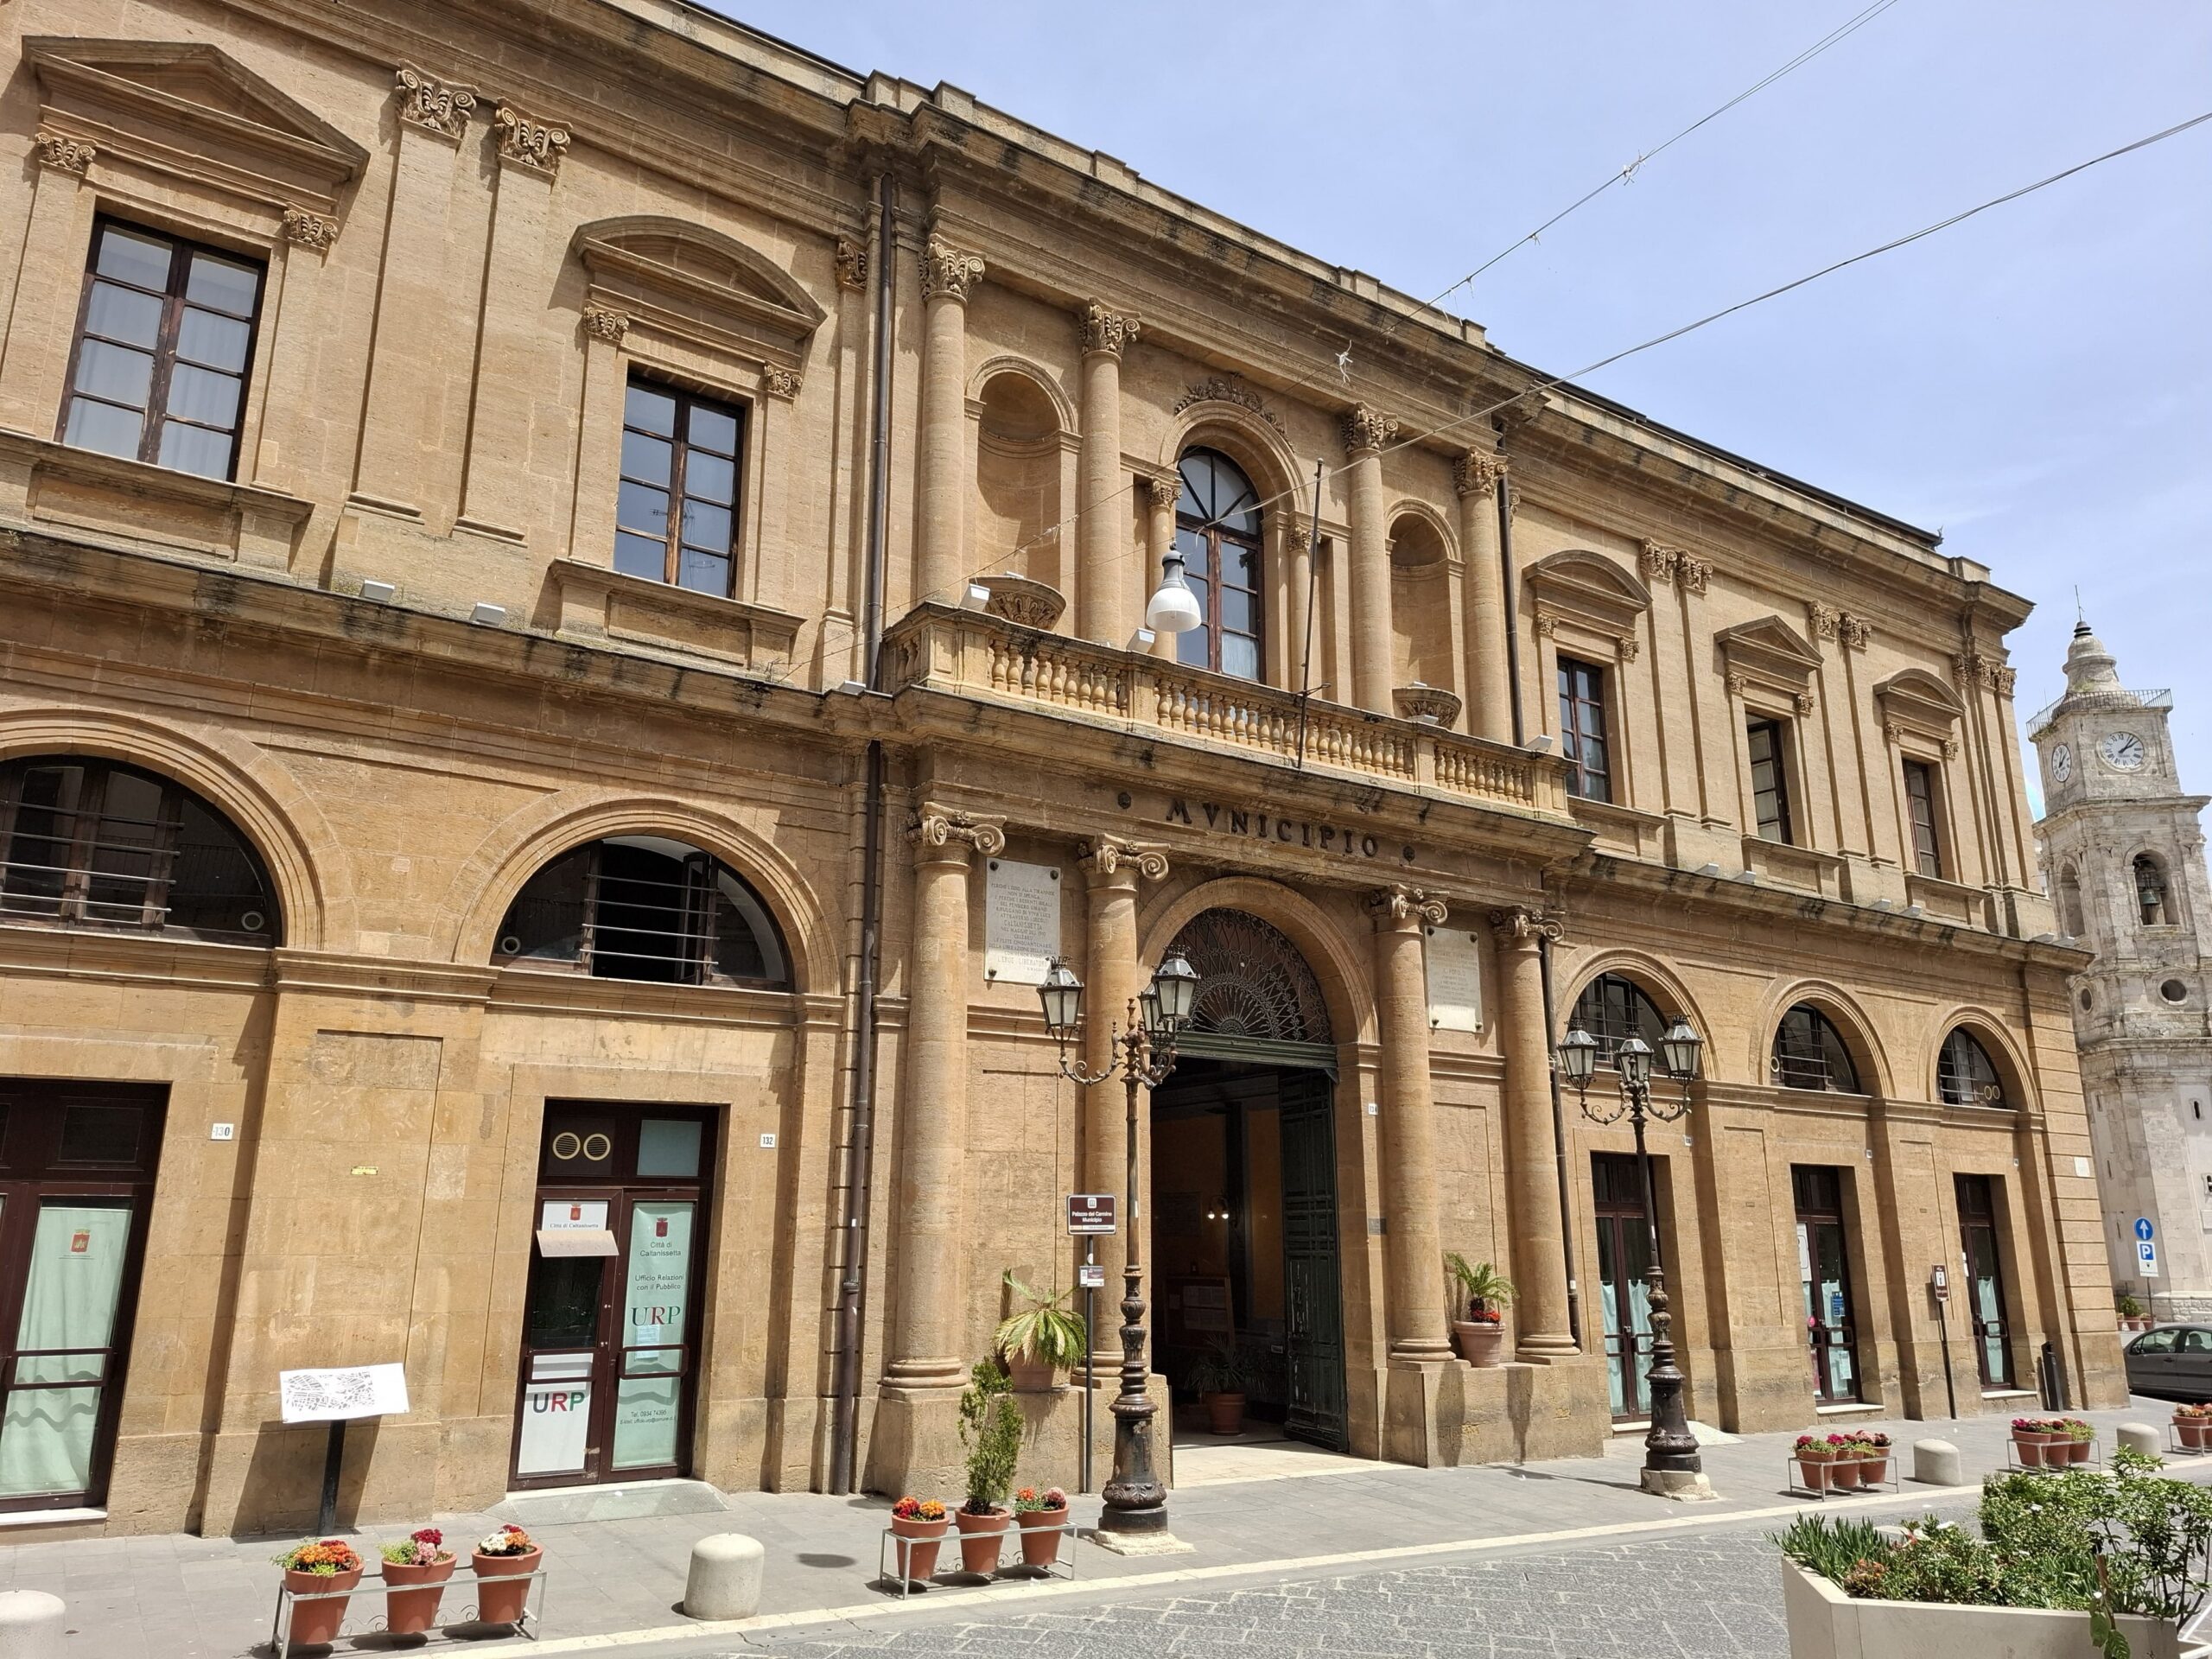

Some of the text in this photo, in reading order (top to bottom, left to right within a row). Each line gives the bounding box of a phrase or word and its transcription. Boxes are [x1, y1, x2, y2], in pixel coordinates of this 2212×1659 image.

[762, 1136, 773, 1145] 132
[2142, 1245, 2151, 1259] P
[631, 1306, 682, 1326] URP
[532, 1391, 586, 1414] URP
